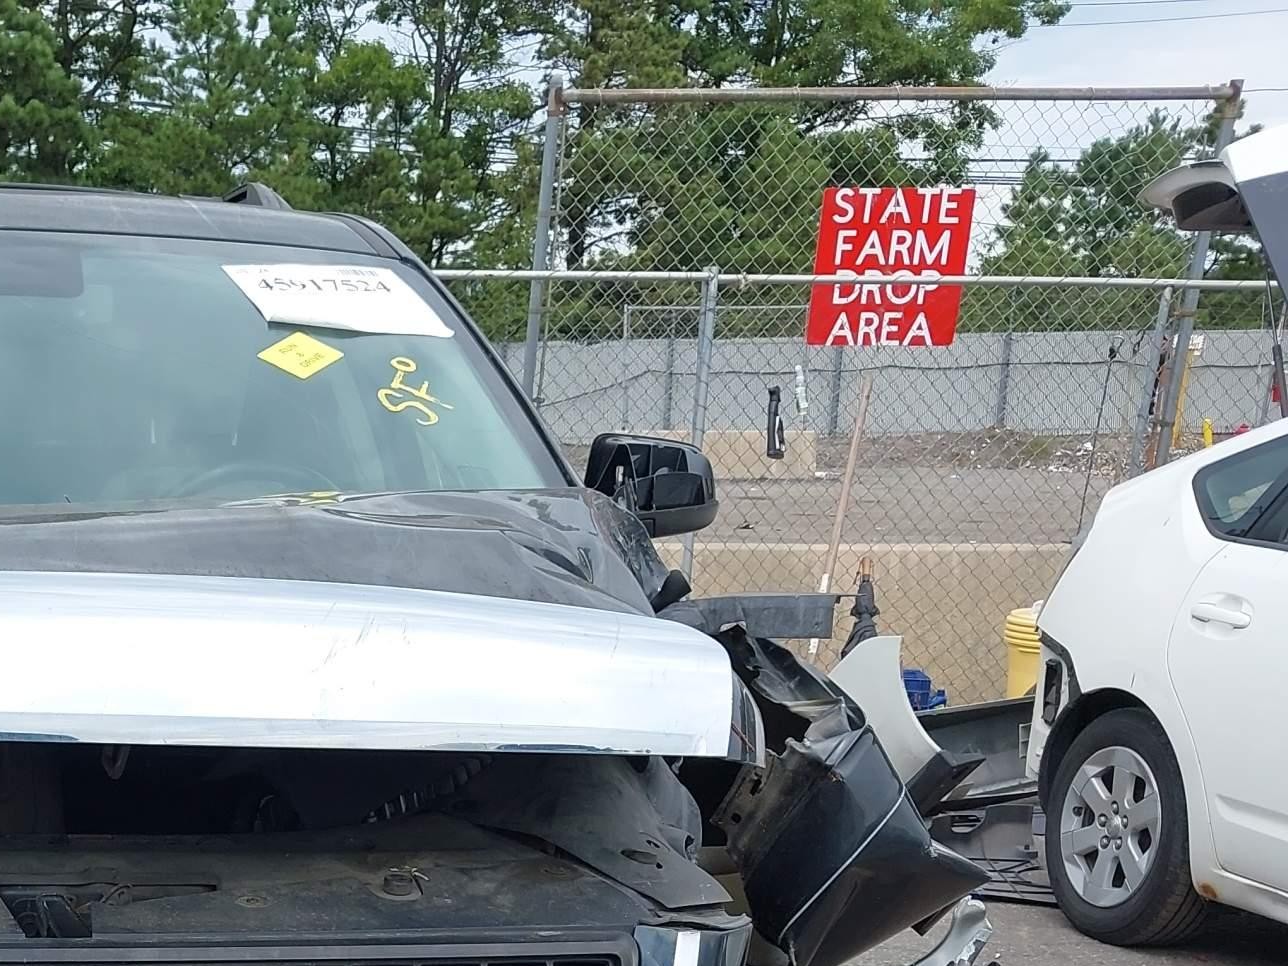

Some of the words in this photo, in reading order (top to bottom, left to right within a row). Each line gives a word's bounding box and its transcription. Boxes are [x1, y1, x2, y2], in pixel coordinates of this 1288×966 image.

[832, 187, 963, 224] STATE
[833, 229, 952, 266] FARM
[832, 269, 943, 305] DROP
[825, 311, 933, 346] AREA
